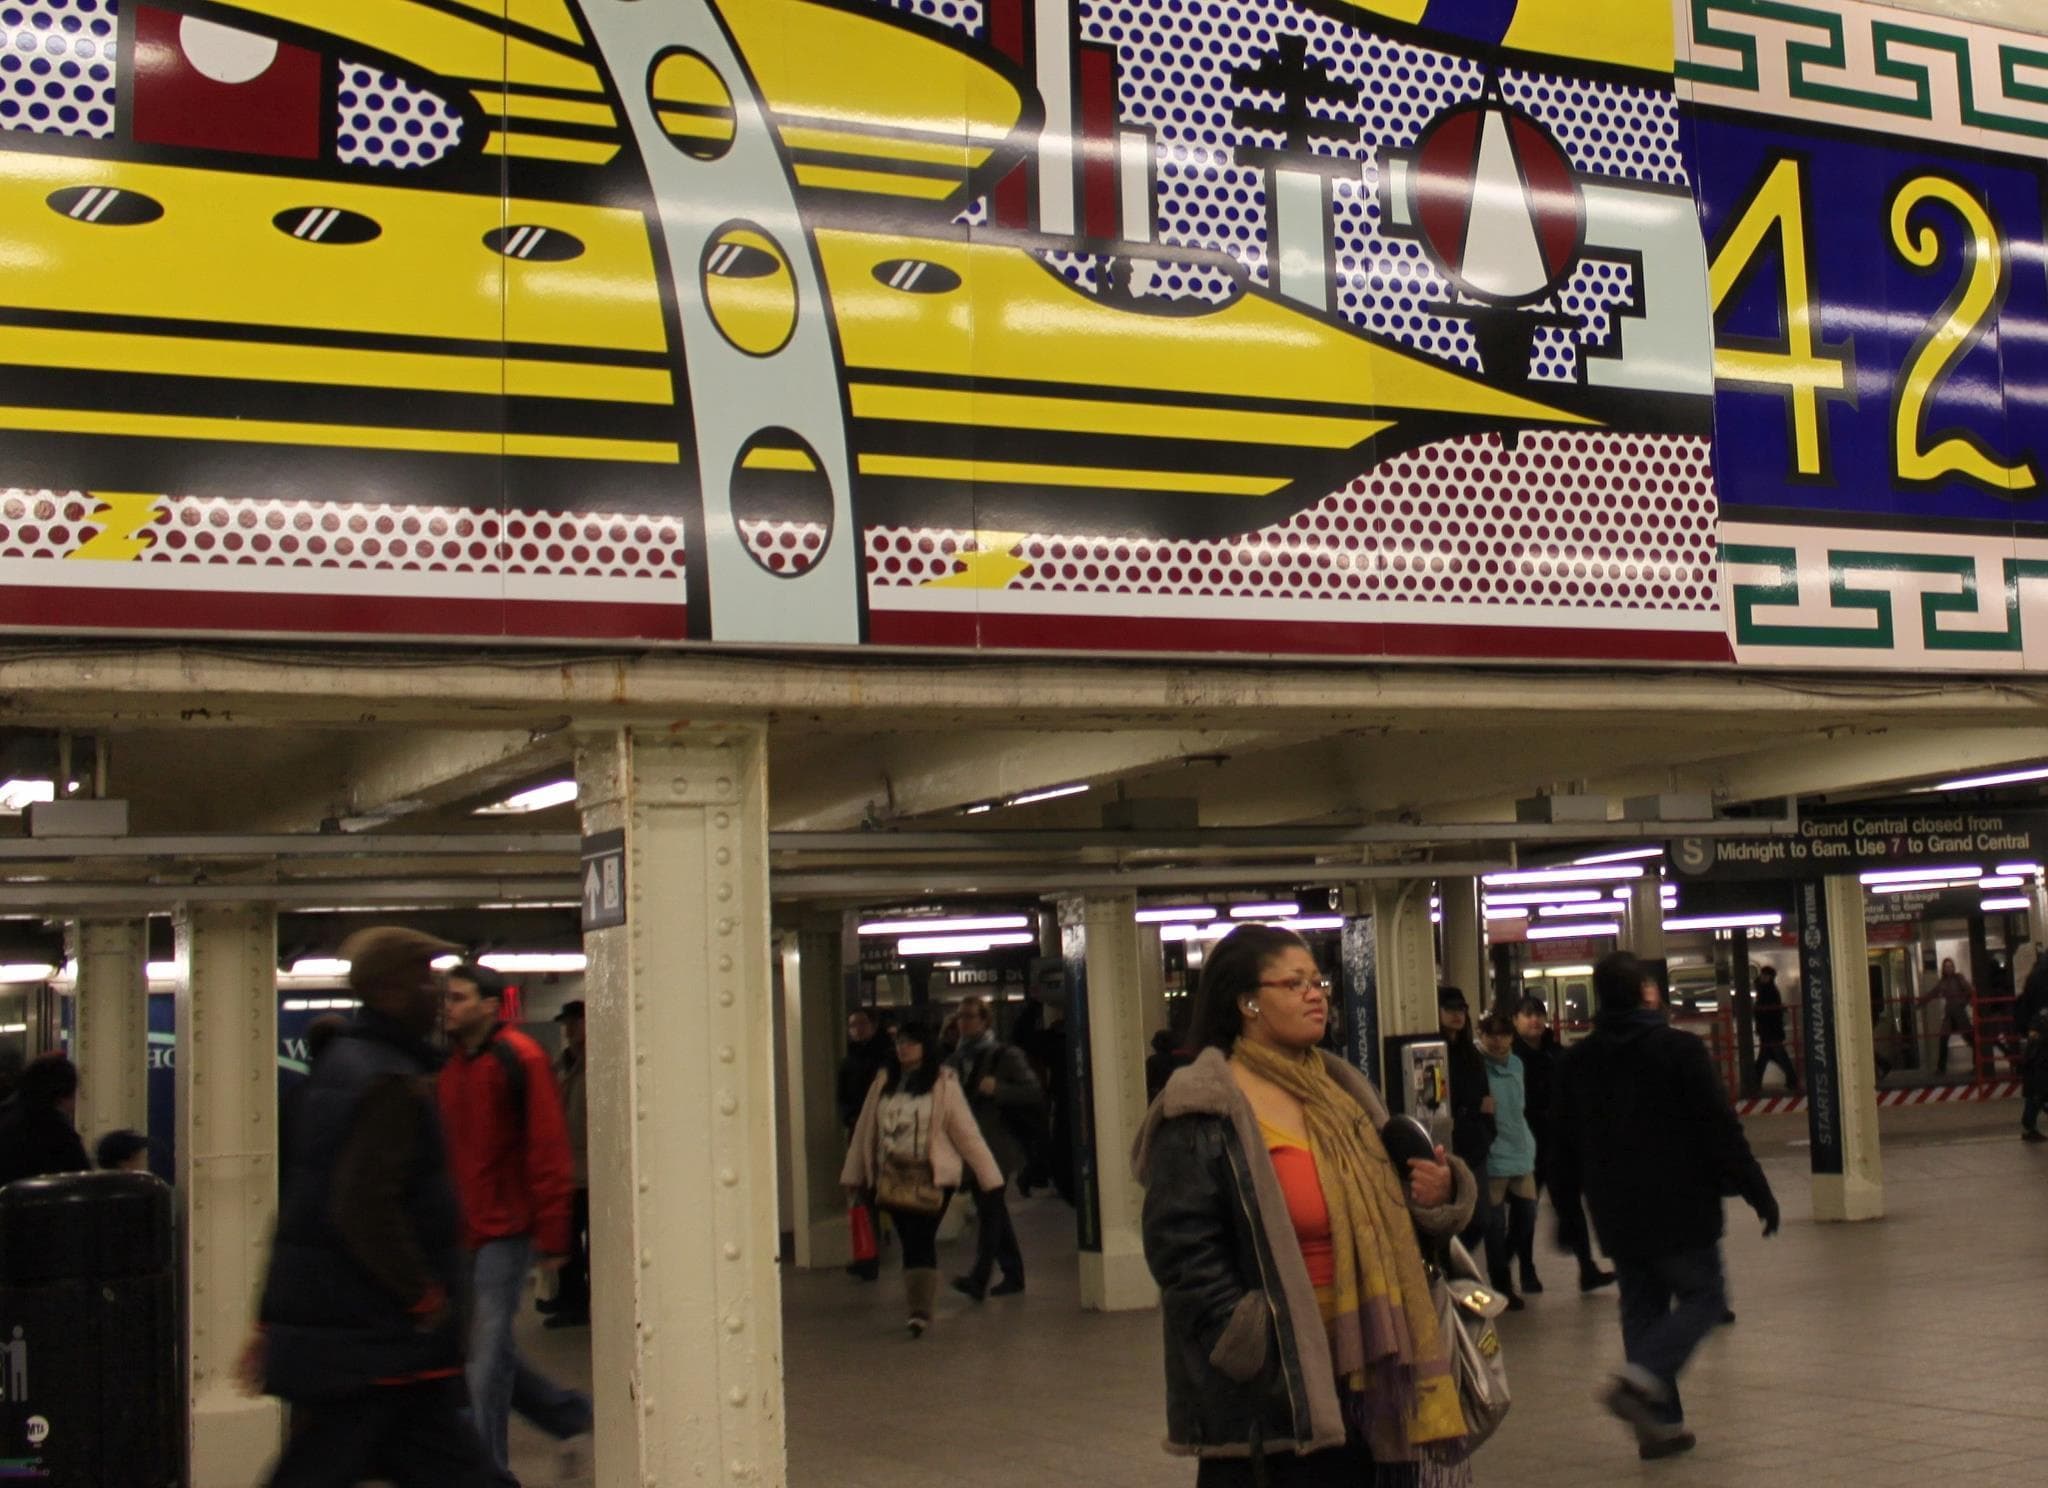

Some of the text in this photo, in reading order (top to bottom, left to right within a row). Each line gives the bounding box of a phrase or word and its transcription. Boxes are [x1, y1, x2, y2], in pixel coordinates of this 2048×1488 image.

[1707, 158, 2036, 490] 42
[1682, 831, 2030, 865] S Midnight to 6am. Use 7 to Grand Central
[1801, 815, 2003, 837] Grand Central closed from
[1356, 1006, 1369, 1080] UNDAYS
[1809, 975, 1827, 1067] JANUARY
[1818, 1072, 1832, 1145] STARTS
